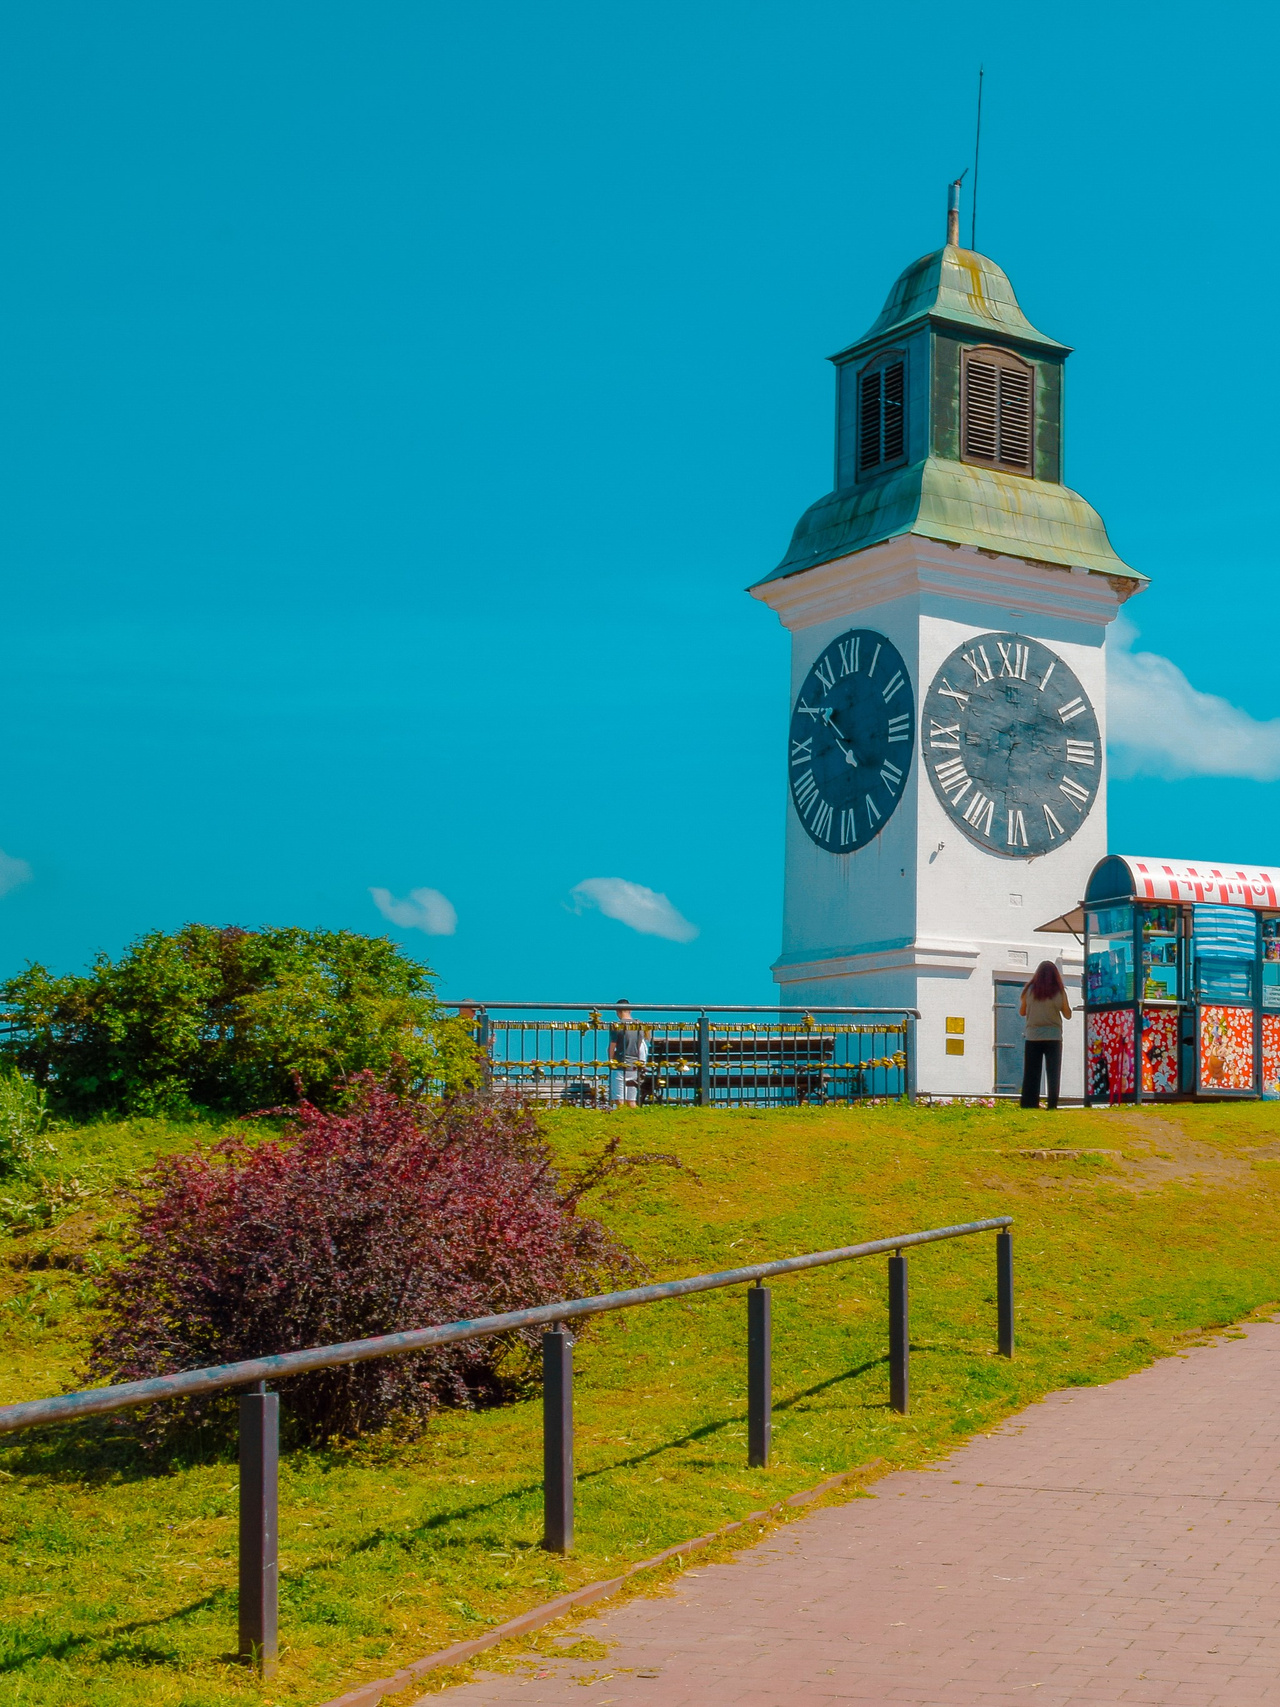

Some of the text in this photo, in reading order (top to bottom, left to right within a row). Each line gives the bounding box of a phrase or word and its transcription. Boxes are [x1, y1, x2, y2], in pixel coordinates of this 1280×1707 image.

[838, 637, 860, 677] XII
[869, 643, 881, 677] I
[962, 645, 994, 687] XI
[997, 642, 1029, 681] XII
[815, 656, 836, 697] XI
[882, 670, 904, 703] II
[938, 677, 969, 711] X
[1038, 661, 1056, 691] I
[798, 697, 820, 722] X
[888, 713, 909, 742] III
[1058, 697, 1086, 723] II
[792, 737, 812, 766] IX
[930, 719, 960, 750] IX
[1066, 739, 1094, 766] III
[794, 768, 819, 819] VIII
[880, 759, 903, 796] IV
[934, 755, 972, 807] VIII
[1059, 776, 1090, 812] IV
[811, 799, 833, 843] VII
[840, 808, 857, 846] VI
[865, 794, 882, 828] V
[962, 791, 994, 837] VII
[1007, 809, 1028, 847] VI
[1042, 804, 1065, 840] V
